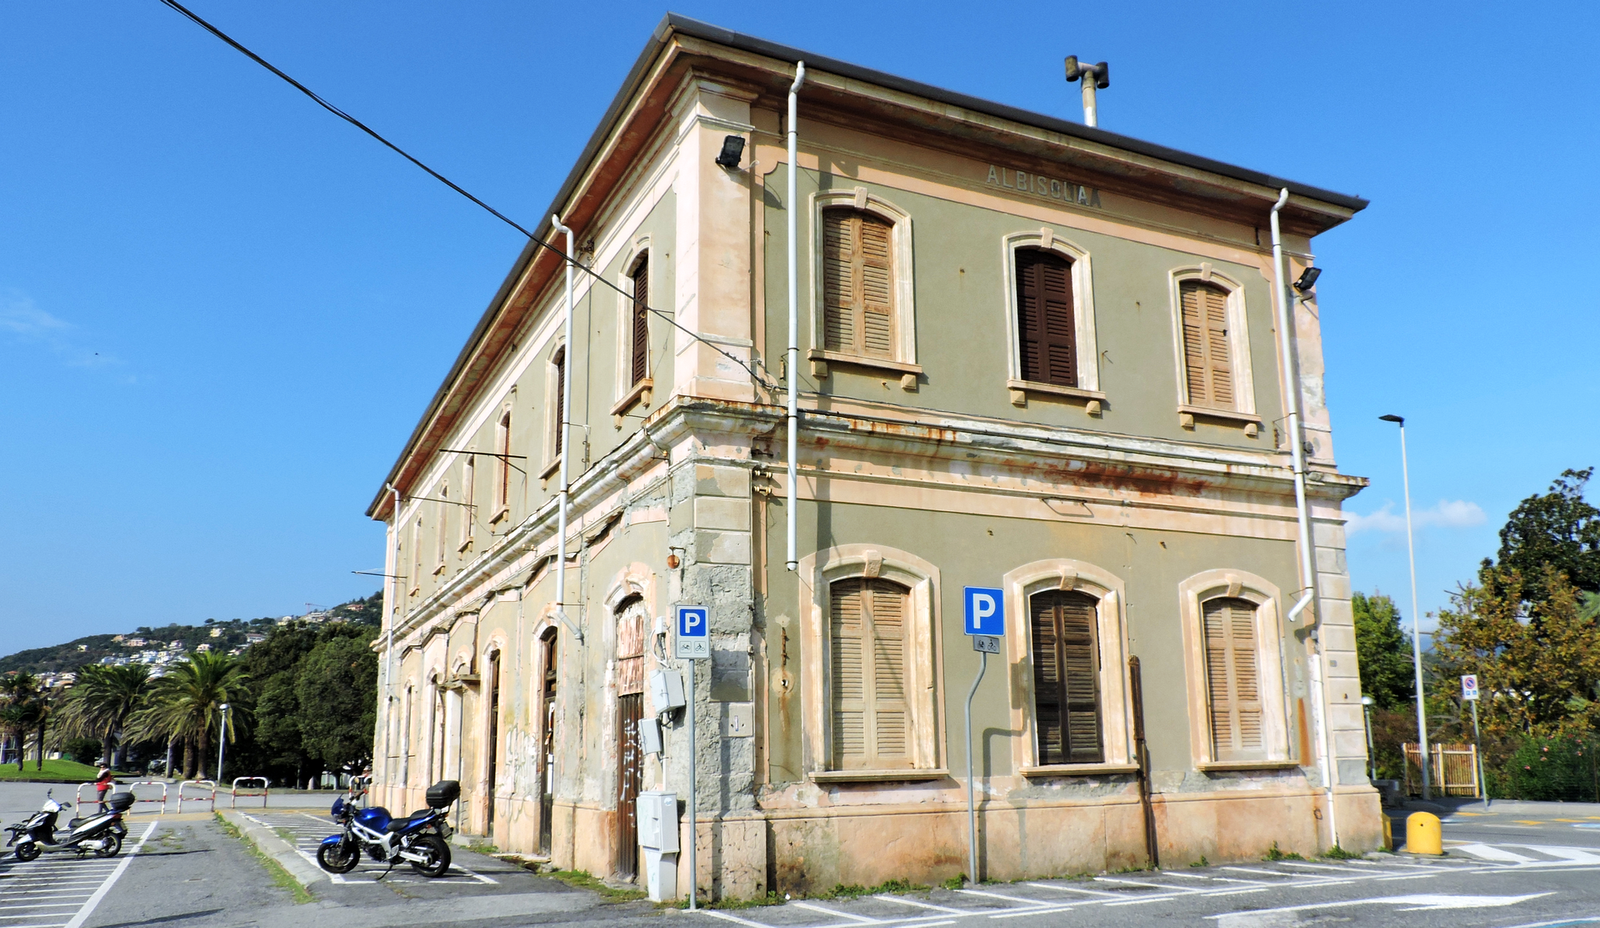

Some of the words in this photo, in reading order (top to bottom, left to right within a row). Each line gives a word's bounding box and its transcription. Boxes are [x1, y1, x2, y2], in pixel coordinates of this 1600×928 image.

[985, 164, 1090, 206] ALBISOLA
[685, 612, 701, 634] P
[972, 593, 996, 629] P
